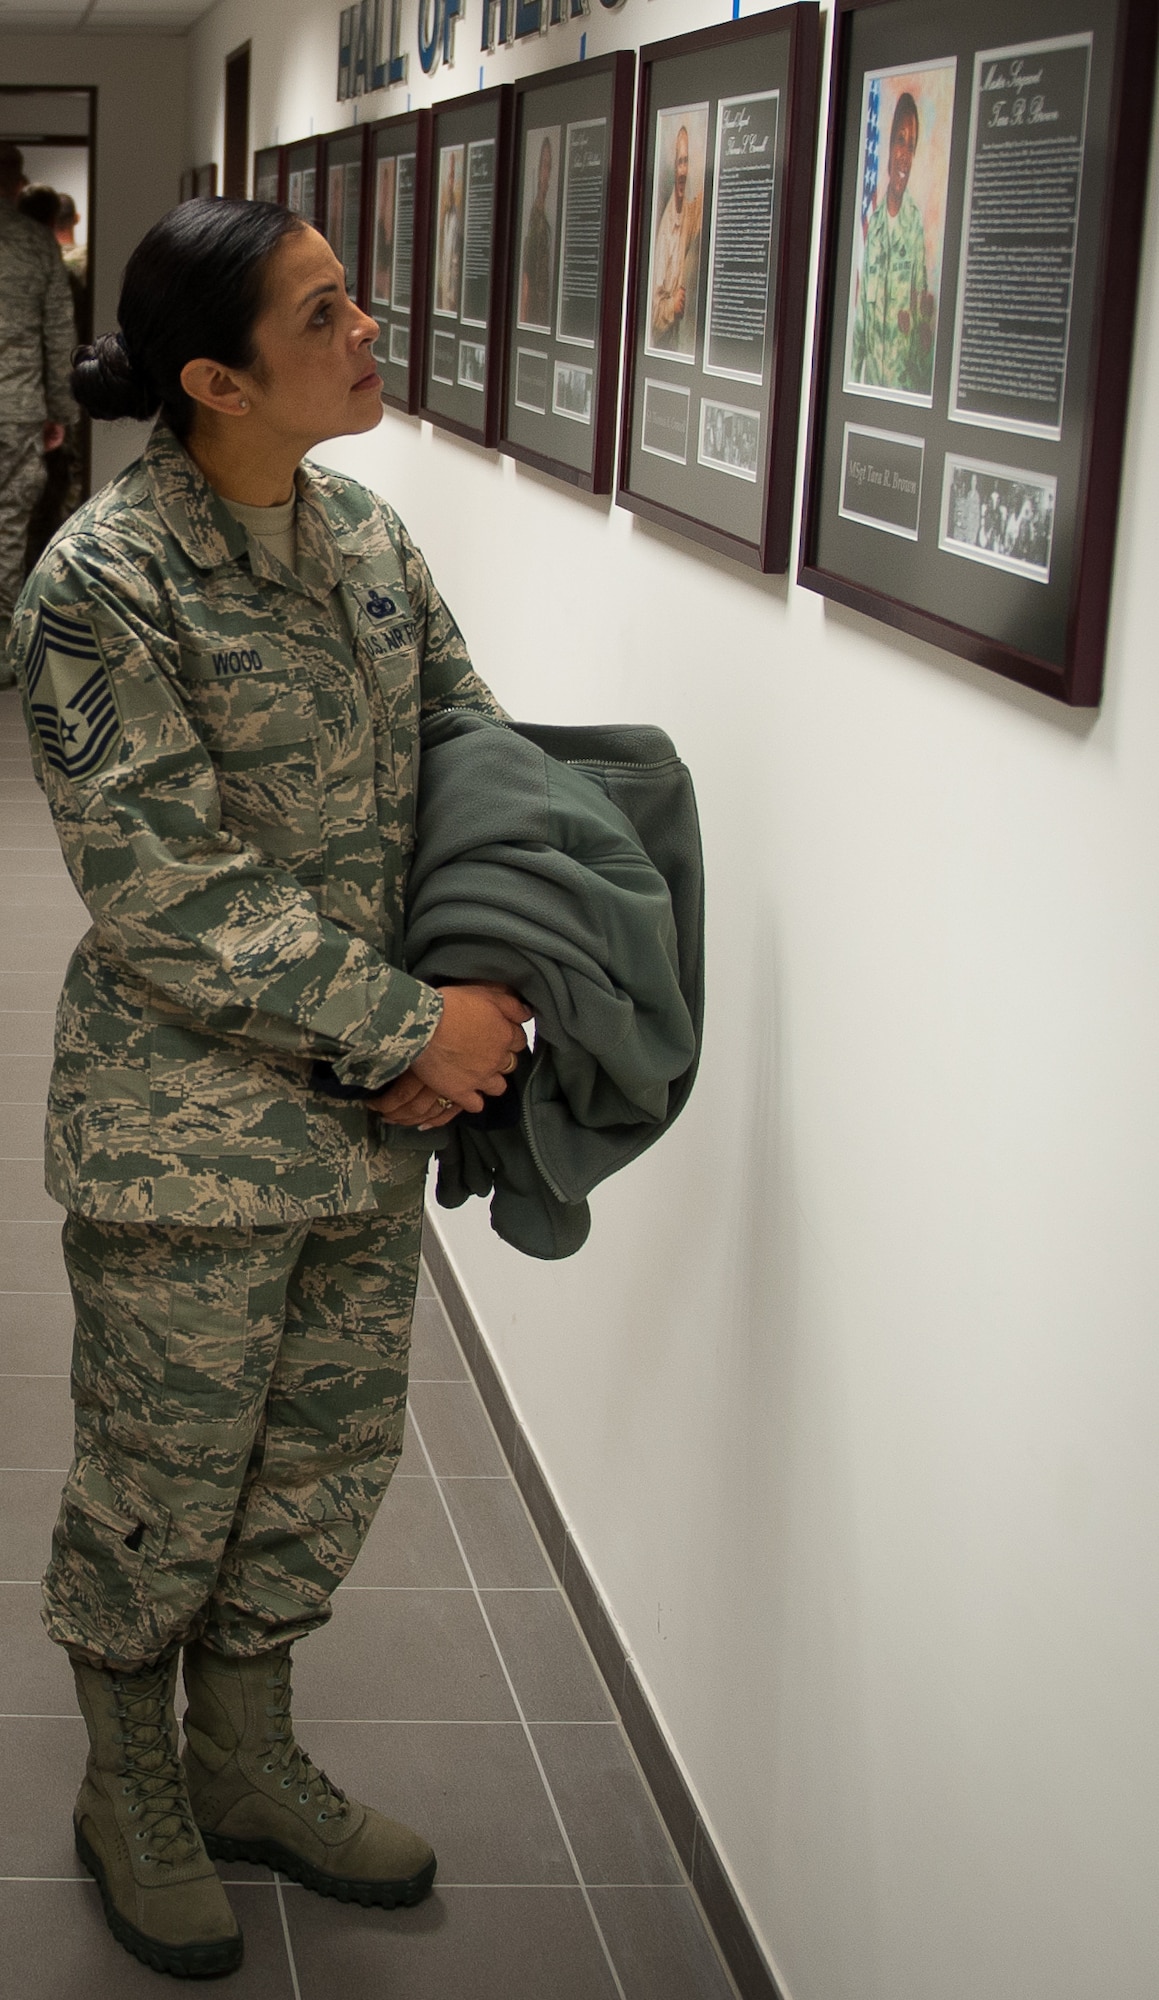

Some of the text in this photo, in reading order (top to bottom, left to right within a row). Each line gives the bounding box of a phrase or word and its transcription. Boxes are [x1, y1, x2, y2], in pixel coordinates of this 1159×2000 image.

[336, 0, 407, 101] HALL
[418, 0, 465, 74] OF
[849, 460, 867, 486] MSgt
[867, 464, 883, 485] Tara
[891, 472, 917, 494] Brown
[361, 635, 388, 656] U.S.
[211, 650, 263, 676] WOOD
